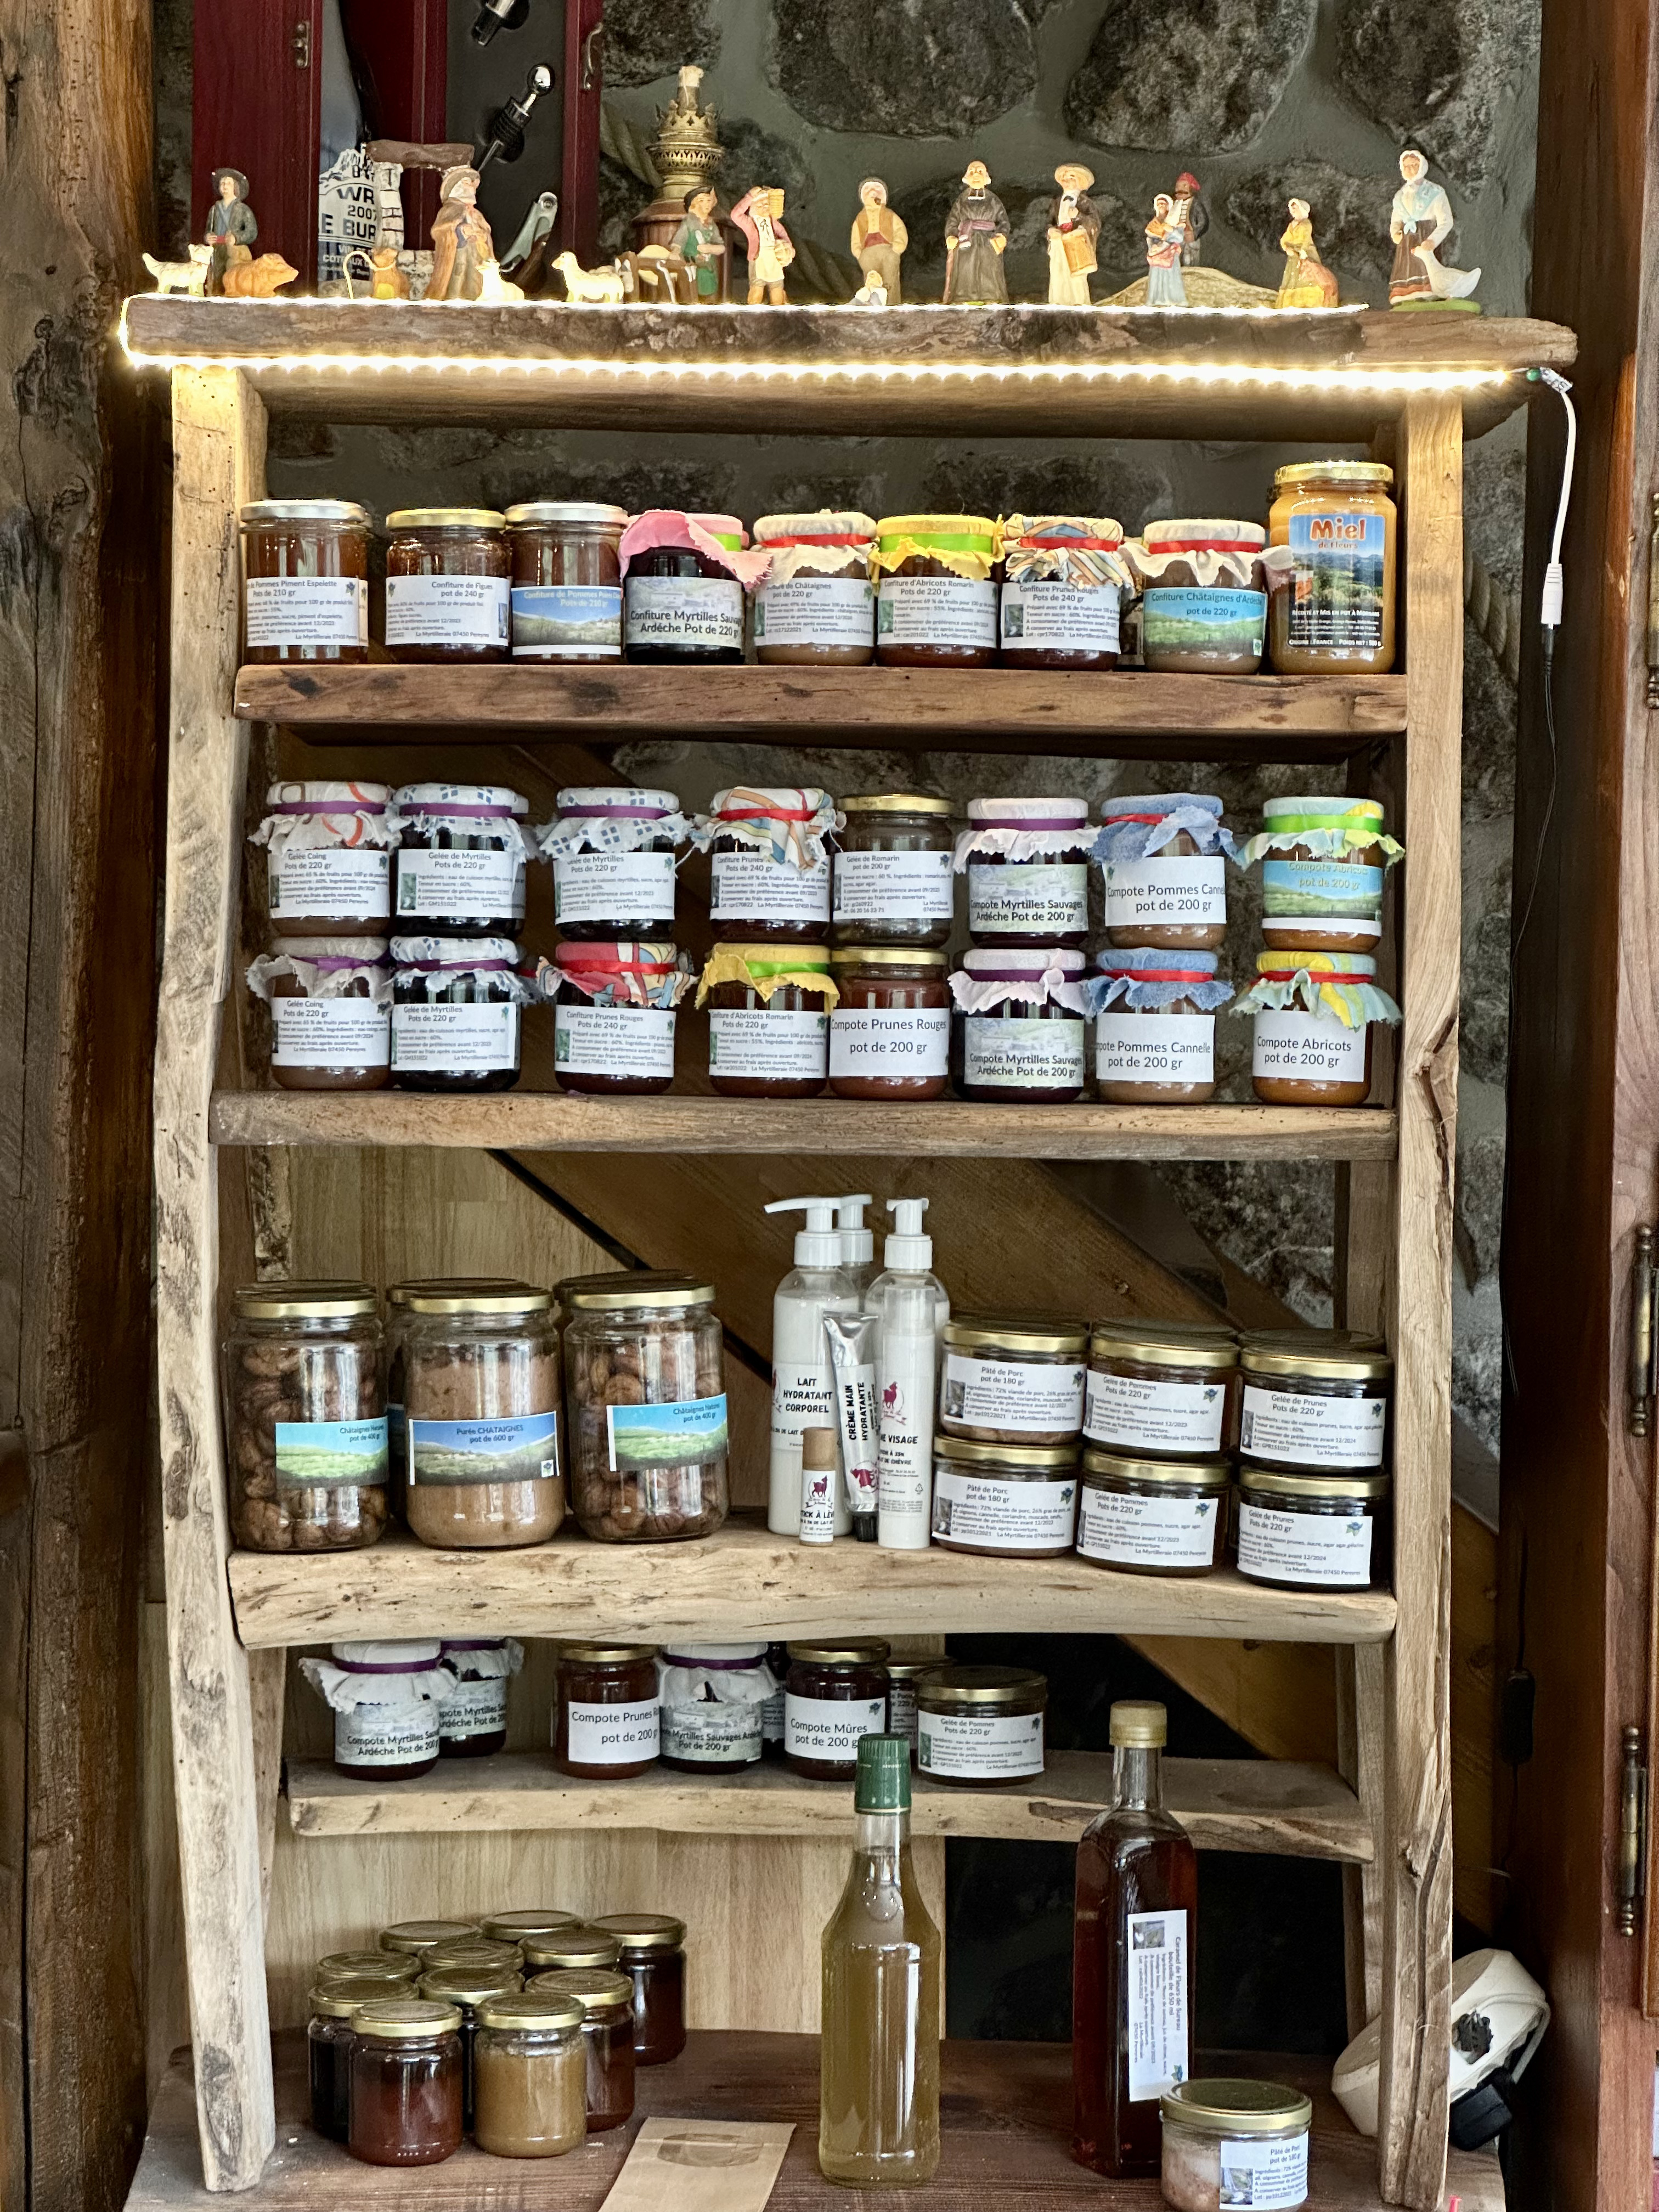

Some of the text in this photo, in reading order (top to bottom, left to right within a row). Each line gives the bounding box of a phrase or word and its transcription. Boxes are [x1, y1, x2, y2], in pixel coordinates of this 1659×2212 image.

[348, 205, 377, 222] 2007
[1311, 518, 1367, 540] Miel
[476, 583, 493, 591] Figues
[948, 580, 974, 589] Romarin
[1152, 592, 1234, 603] Confiture Châtaignes
[630, 610, 718, 623] Confiture Myrtilles
[1187, 609, 1199, 617] pot
[685, 624, 702, 633] Pot
[705, 625, 716, 634] de
[719, 627, 732, 636] 220
[462, 853, 491, 861] Myrtilles
[1108, 885, 1199, 899] Compote Pommes
[1001, 900, 1045, 911] Myrtilles
[1136, 899, 1211, 913] pot de 200 gr
[1012, 912, 1029, 921] Pot
[1032, 912, 1045, 921] de
[1047, 912, 1065, 921] 200
[567, 1012, 593, 1020] Confiture
[620, 1014, 643, 1023] Rouges
[831, 1019, 946, 1031] Compote Prunes Rouges
[850, 1041, 927, 1054] pot de 200 gr
[1118, 1041, 1211, 1053] Pommes Cannelle
[1257, 1036, 1351, 1052] Compote Abricots
[969, 1053, 1049, 1065] Compote Myrtilles
[1108, 1056, 1183, 1070] pot de 200 gr
[1265, 1052, 1340, 1068] pot de 200 gr
[1017, 1066, 1034, 1076] Pot
[1037, 1066, 1049, 1076] de
[1052, 1067, 1067, 1076] 200
[797, 1378, 817, 1386] LAIT
[783, 1390, 832, 1400] HYDRATANT
[1272, 1394, 1290, 1404] Gelée
[786, 1403, 829, 1413] CORPOREL
[845, 1385, 857, 1440] CRÈME MAIN
[857, 1382, 868, 1441] HYDRATANTE
[477, 1425, 524, 1434] CHATAIGNES
[888, 1435, 918, 1444] VISAGE
[572, 1711, 652, 1724] Compote Prunes
[941, 1718, 957, 1726] Gelée
[791, 1718, 867, 1734] Compote Mûres
[602, 1729, 652, 1744] pot de 200
[795, 1735, 858, 1749] pot de 200 g
[1175, 1966, 1181, 1974] de
[1175, 1997, 1181, 2006] de
